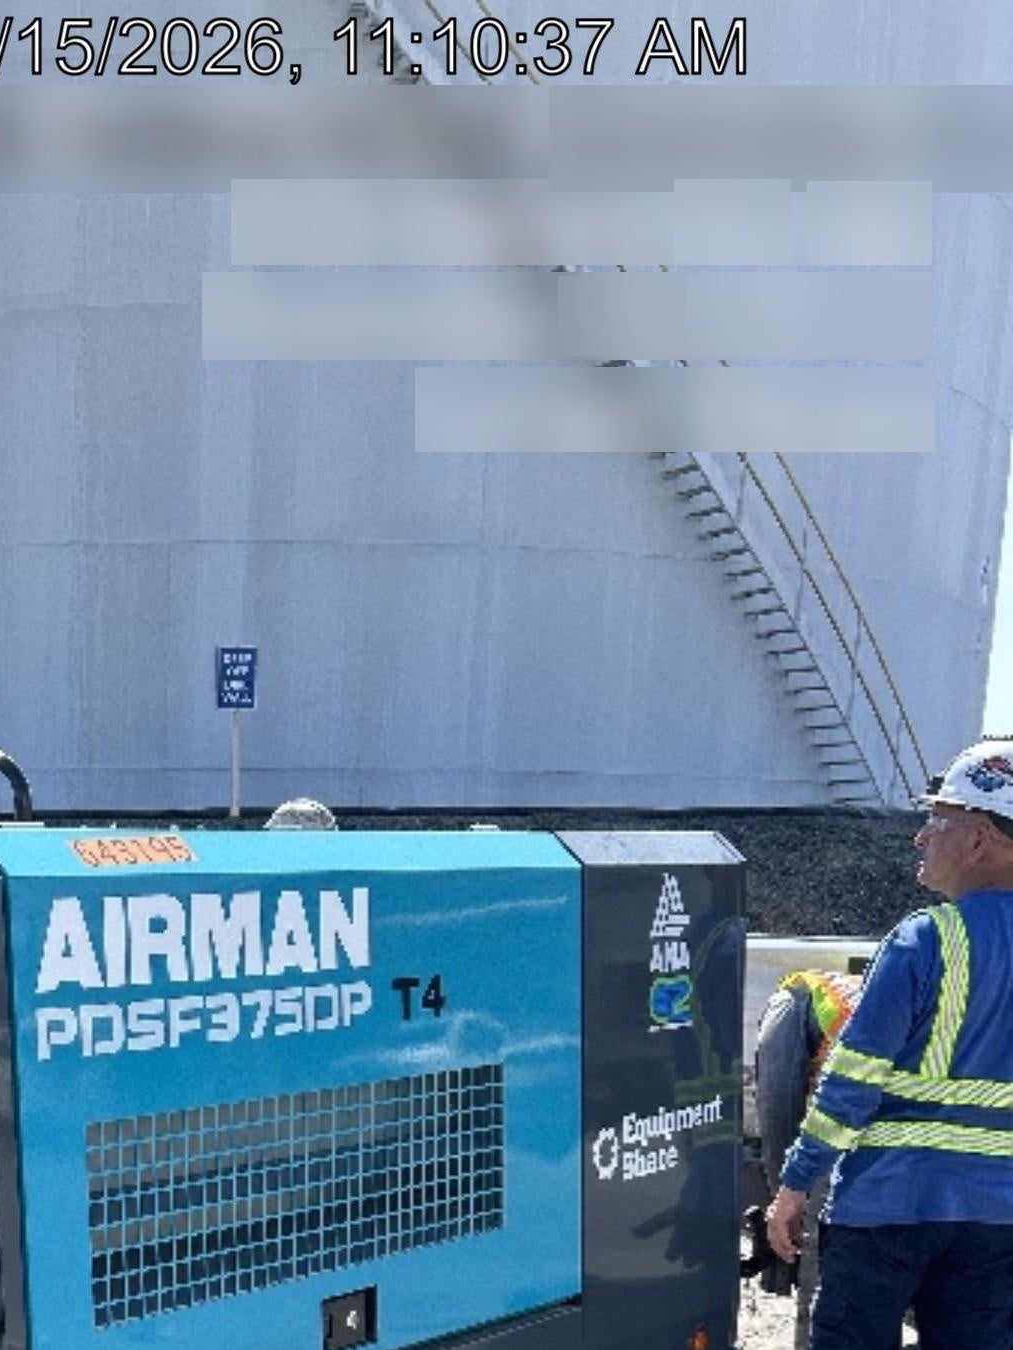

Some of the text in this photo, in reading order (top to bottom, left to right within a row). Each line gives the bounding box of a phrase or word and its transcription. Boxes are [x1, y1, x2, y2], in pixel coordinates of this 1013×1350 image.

[35, 887, 371, 994] AIRMAN
[649, 941, 691, 973] ANA
[35, 975, 447, 1062] PDSF375DP T4
[623, 1094, 723, 1147] Equipment
[623, 1146, 679, 1181] Share
